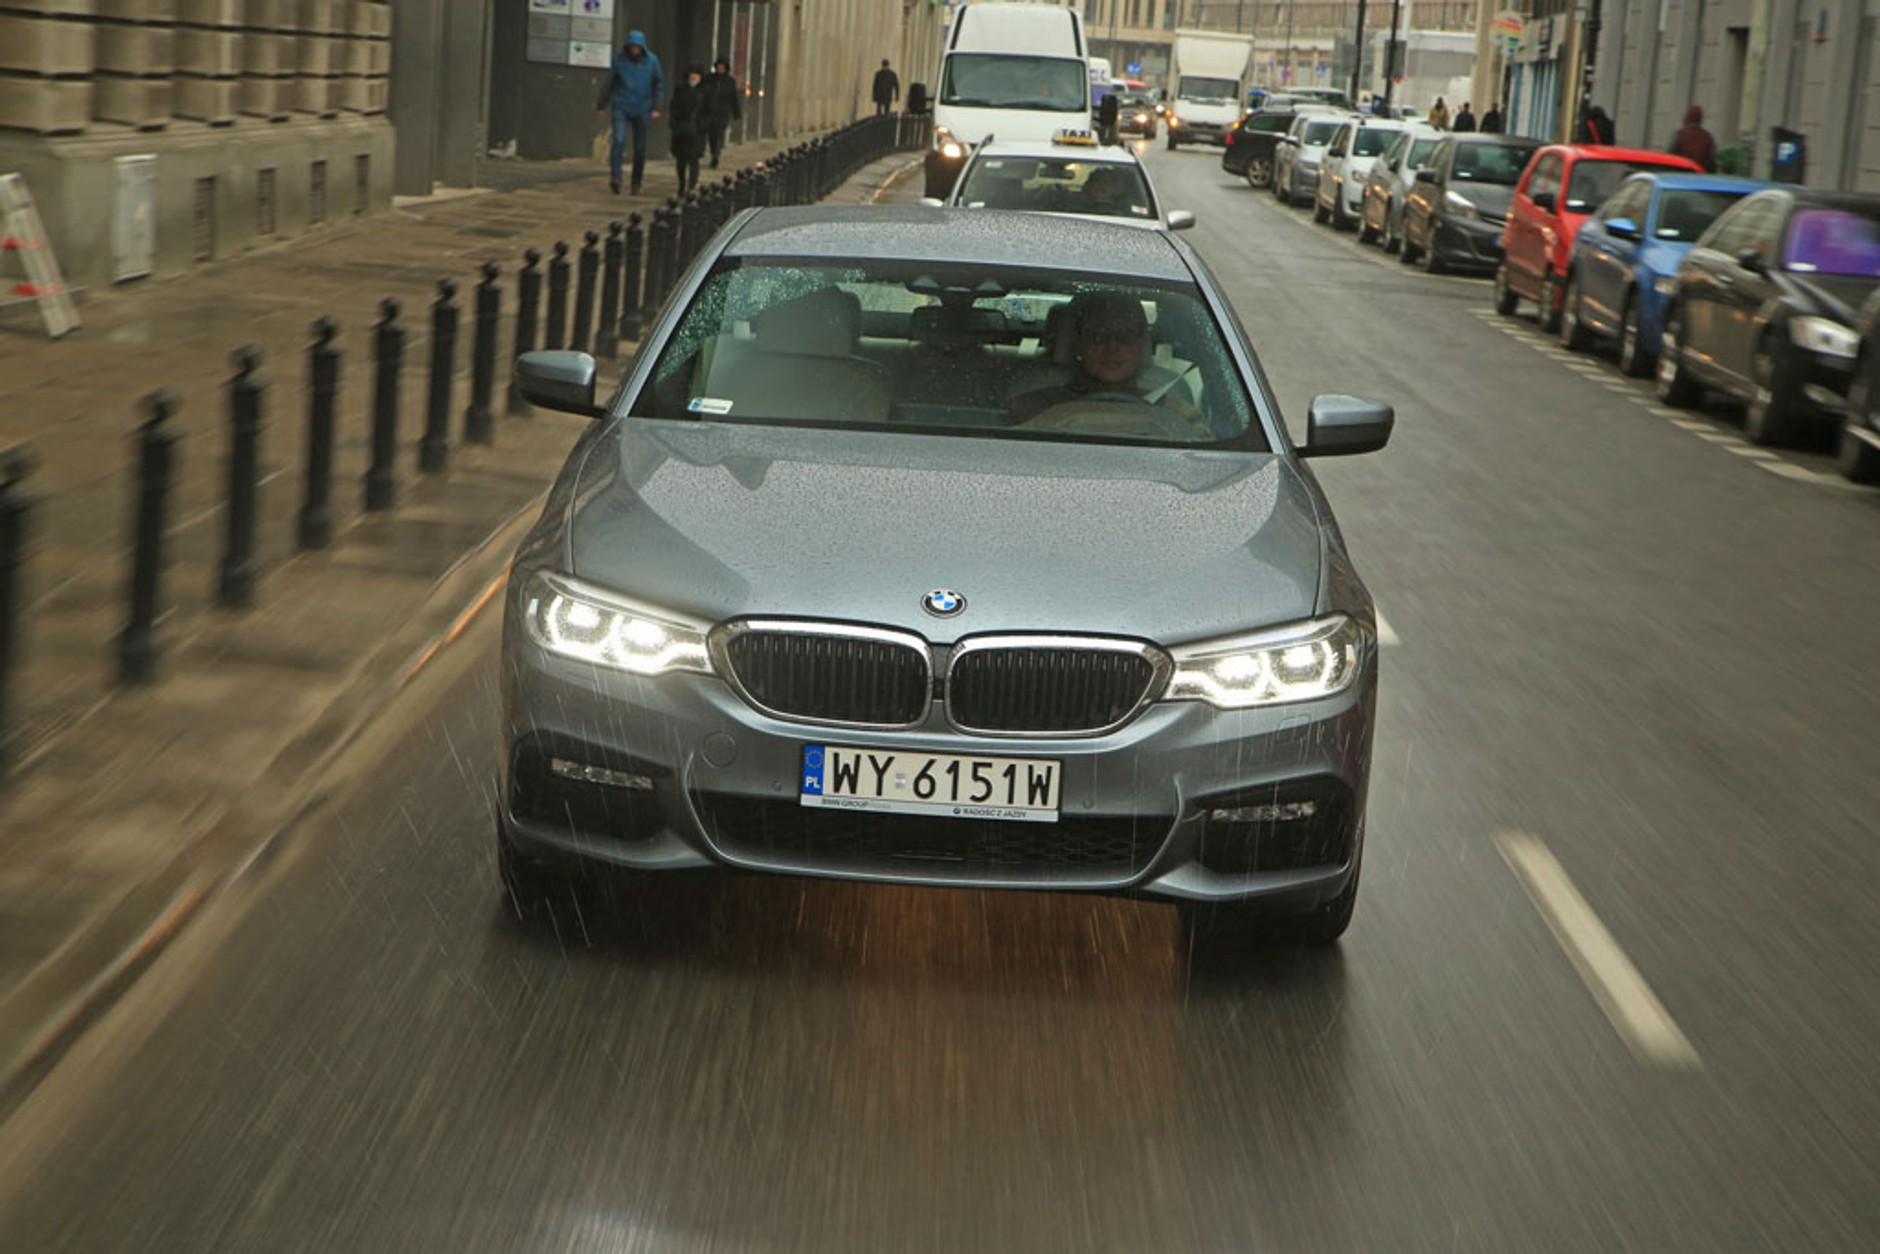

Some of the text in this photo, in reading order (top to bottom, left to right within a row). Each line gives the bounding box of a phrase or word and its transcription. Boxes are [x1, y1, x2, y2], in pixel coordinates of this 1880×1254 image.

[1061, 128, 1092, 138] TAXI
[805, 775, 820, 789] PL
[833, 752, 1053, 806] WY 6151W
[841, 799, 869, 808] GROUP
